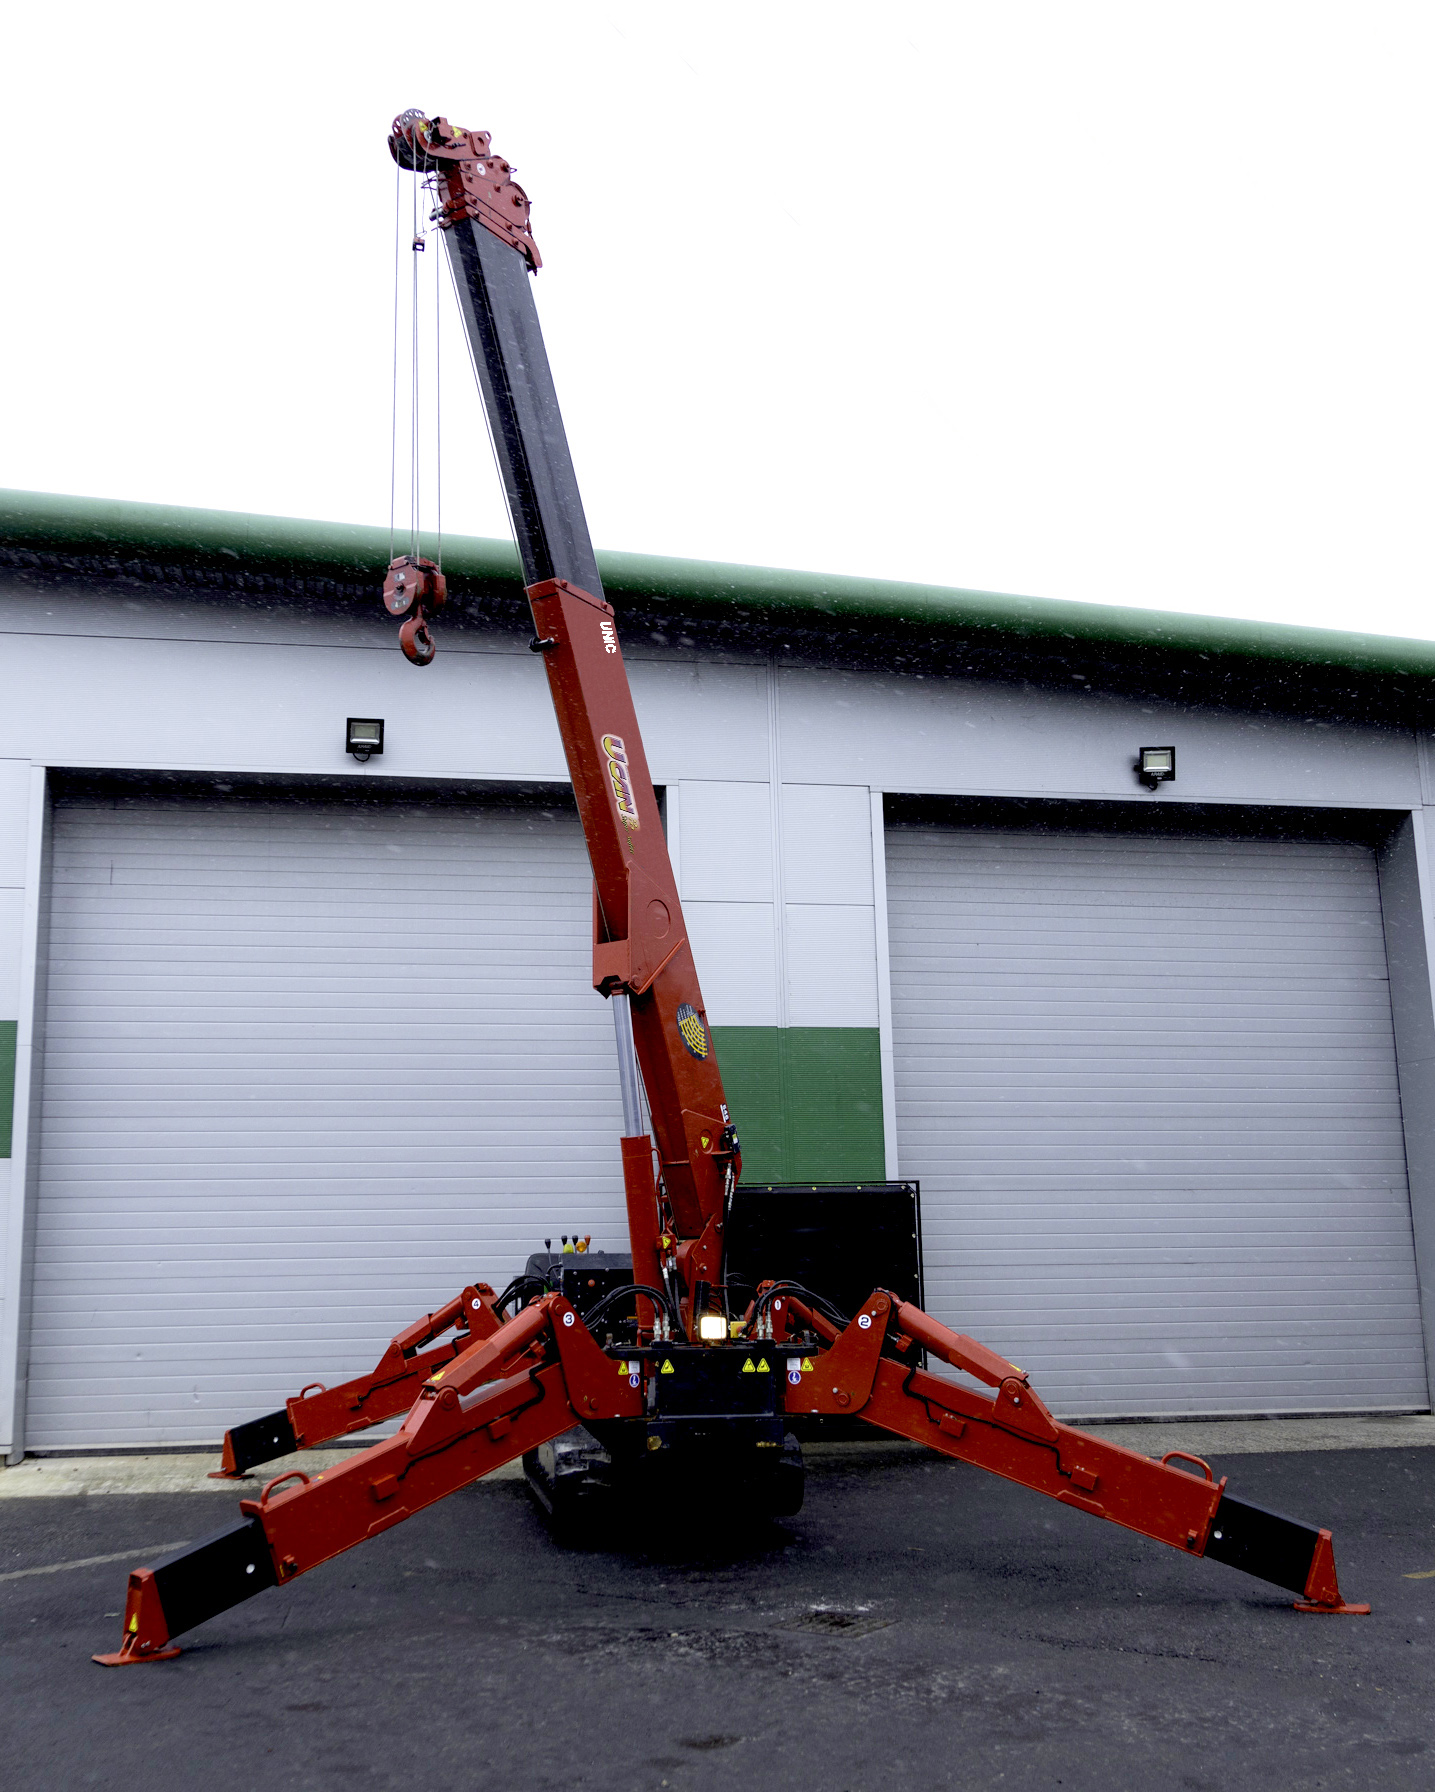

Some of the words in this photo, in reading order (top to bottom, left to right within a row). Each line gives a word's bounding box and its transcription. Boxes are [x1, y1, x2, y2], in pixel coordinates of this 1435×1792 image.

[600, 621, 617, 654] UNIC
[602, 735, 637, 817] UCAN
[565, 1313, 573, 1325] 3
[860, 1316, 870, 1327] 2
